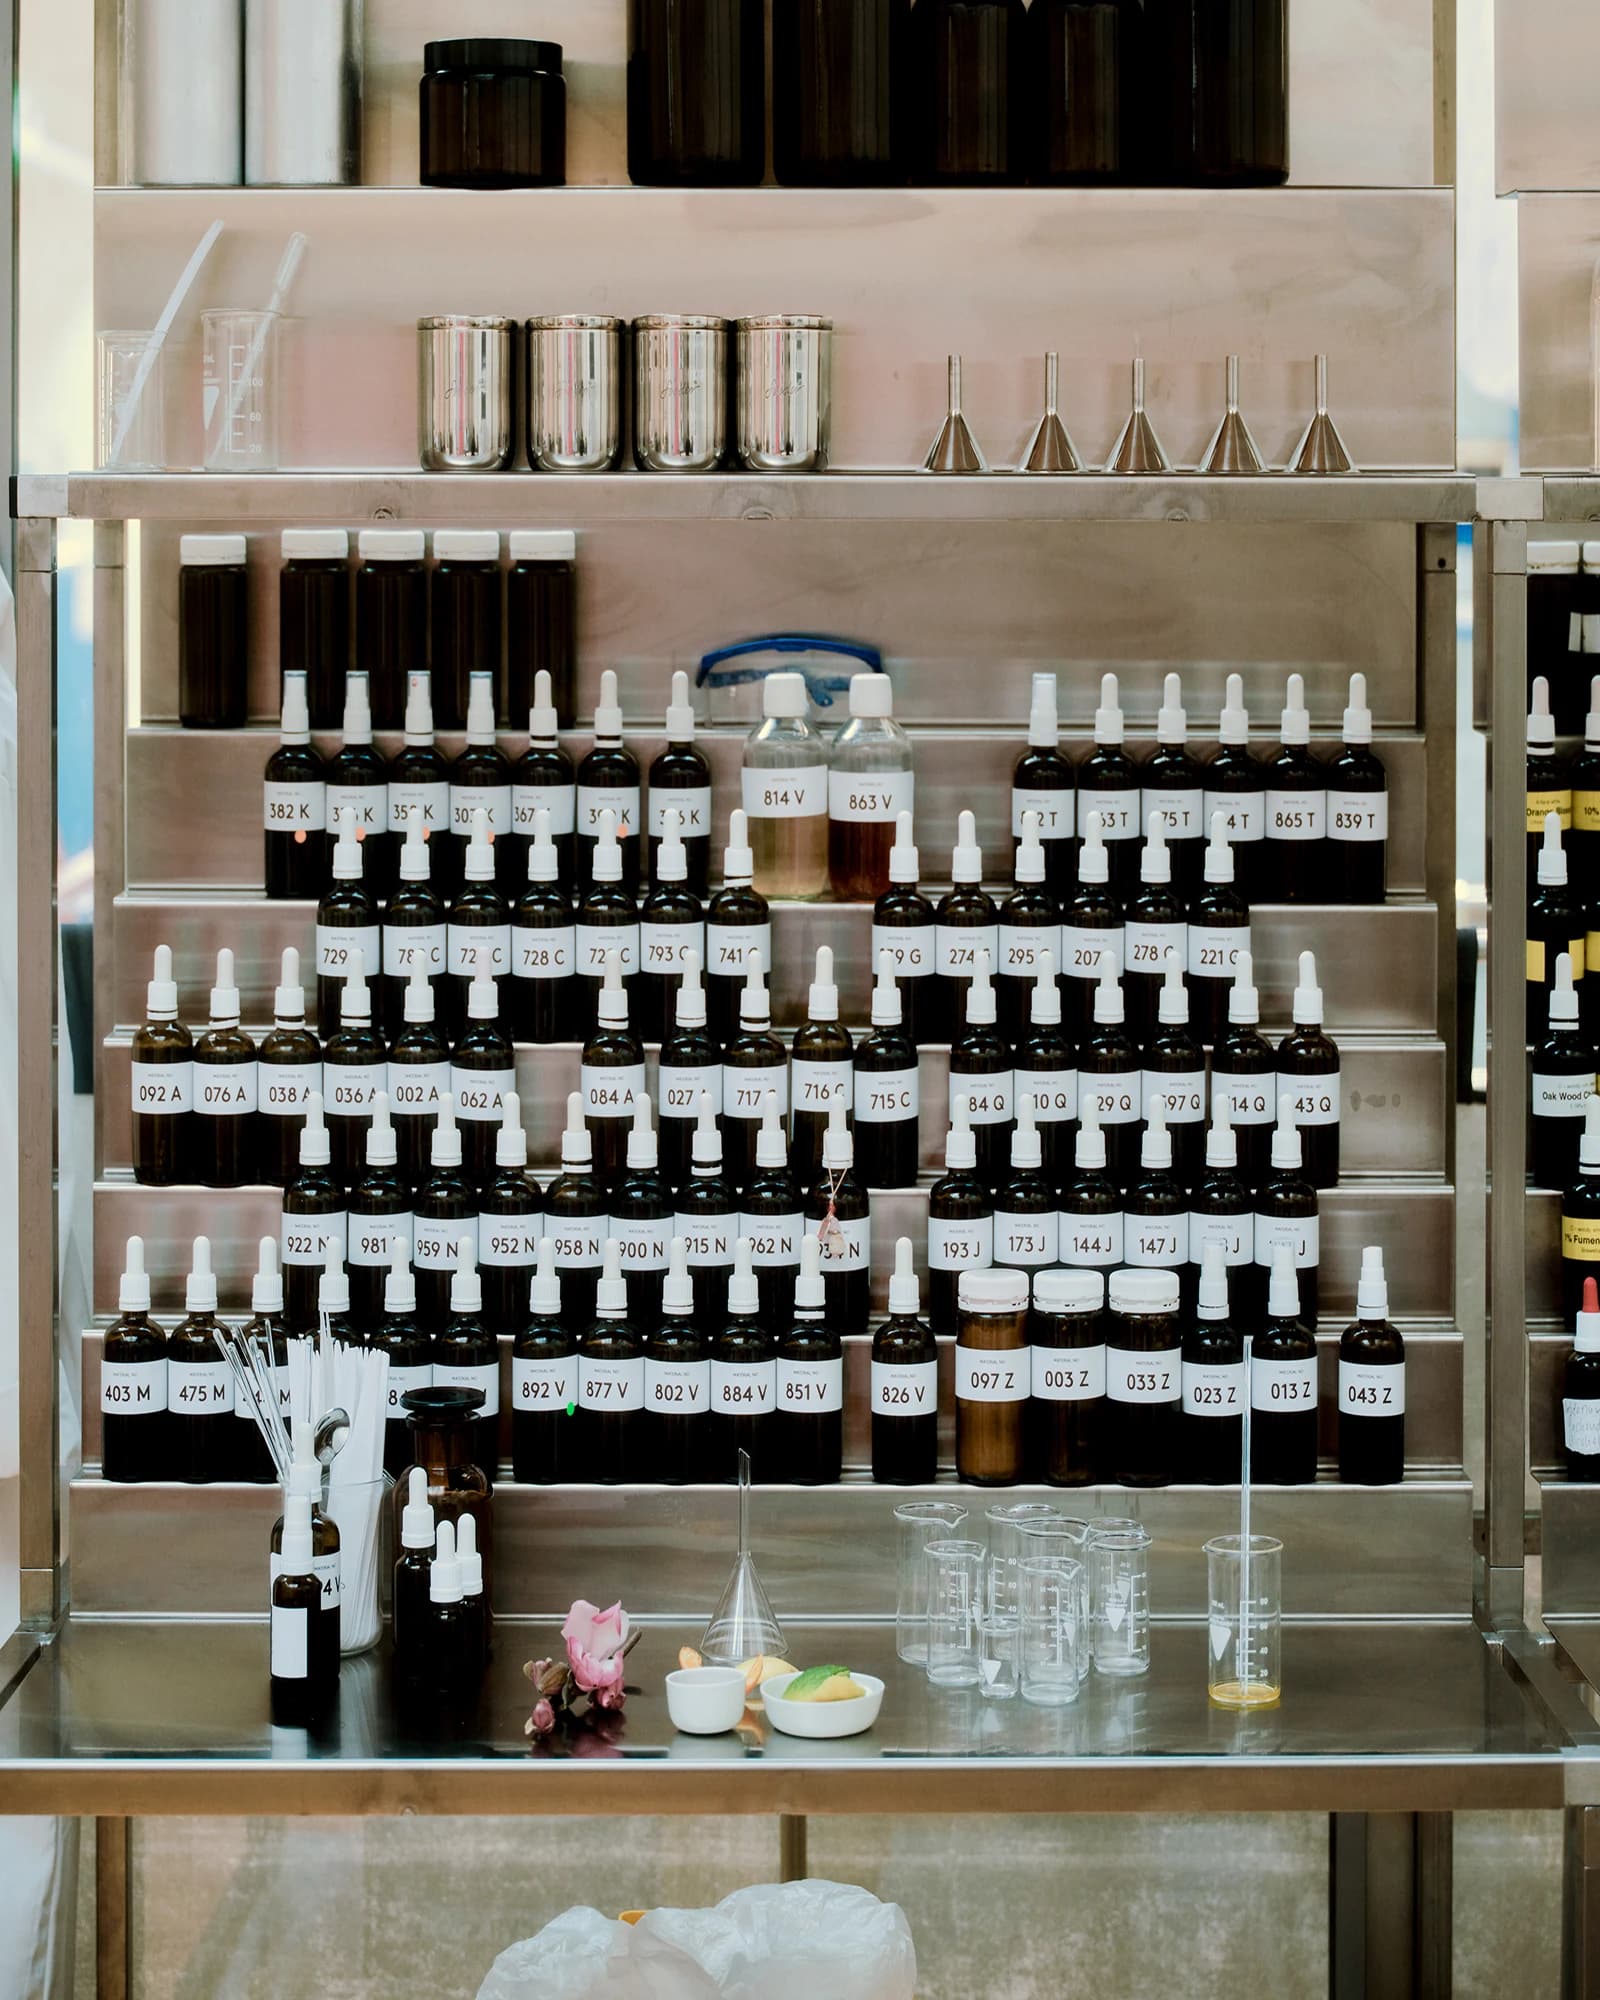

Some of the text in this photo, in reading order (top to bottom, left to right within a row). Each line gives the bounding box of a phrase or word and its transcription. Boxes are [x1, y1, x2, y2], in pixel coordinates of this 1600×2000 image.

[764, 790, 804, 805] 814 V
[850, 795, 892, 810] 863 V
[270, 803, 309, 819] 382 K
[364, 808, 373, 822] K
[424, 805, 433, 819] K
[514, 807, 535, 824] 367
[622, 809, 630, 824] K
[691, 810, 700, 824] K
[1049, 812, 1057, 826] T
[1182, 811, 1190, 826] T
[1120, 812, 1128, 827] T
[1241, 814, 1249, 829] T
[1276, 812, 1315, 827] 865 T
[1336, 813, 1375, 828] 839 T
[324, 948, 347, 964] 729
[431, 947, 440, 962] C
[492, 948, 501, 963] C
[524, 950, 564, 965] 728 C
[621, 948, 630, 963] C
[649, 945, 673, 961] 793
[720, 948, 741, 963] 741
[910, 949, 921, 964] G
[1009, 948, 1034, 964] 295
[1075, 950, 1101, 966] 207
[1134, 945, 1158, 961] 278
[1200, 949, 1223, 965] 221
[140, 1086, 181, 1101] 092 A
[205, 1086, 246, 1102] 076 A
[270, 1087, 296, 1102] 038
[336, 1088, 363, 1103] 036
[397, 1086, 439, 1102] 002 A
[591, 1089, 633, 1104] 084 A
[668, 1089, 693, 1105] 027
[737, 1090, 761, 1106] 717
[805, 1083, 829, 1099] 716
[1559, 1092, 1581, 1101] Wood
[461, 1091, 503, 1108] 062 A
[871, 1092, 910, 1109] 715 C
[994, 1095, 1004, 1110] Q
[1055, 1093, 1066, 1108] Q
[1120, 1095, 1131, 1111] Q
[1191, 1094, 1200, 1109] Q
[1254, 1096, 1265, 1112] Q
[1320, 1097, 1330, 1112] Q
[288, 1236, 312, 1253] 922
[362, 1238, 386, 1253] 981
[418, 1240, 458, 1257] 959 N
[492, 1237, 534, 1253] 952 N
[555, 1239, 598, 1255] 958 N
[620, 1242, 663, 1258] 900 N
[685, 1237, 726, 1254] 915 N
[781, 1237, 791, 1253] N
[850, 1242, 859, 1258] N
[944, 1241, 979, 1258] 193 J
[1009, 1236, 1045, 1252] 173 J
[1074, 1237, 1111, 1253] 144 J
[1140, 1237, 1176, 1254] 147 J
[1233, 1238, 1239, 1253] J
[1299, 1240, 1305, 1256] J
[971, 1372, 1014, 1389] 097 Z
[1046, 1371, 1088, 1387] 003 Z
[1127, 1373, 1169, 1390] 033 Z
[106, 1385, 150, 1402] 403 M
[180, 1384, 224, 1401] 475 M
[523, 1380, 565, 1398] 892 V
[587, 1381, 628, 1398] 877 V
[655, 1384, 698, 1401] 802 V
[723, 1385, 767, 1402] 884 V
[786, 1383, 826, 1400] 851 V
[882, 1386, 925, 1403] 826 V
[1194, 1387, 1236, 1404] 023 Z
[1271, 1382, 1310, 1399] 013 Z
[1349, 1386, 1392, 1404] 043 Z
